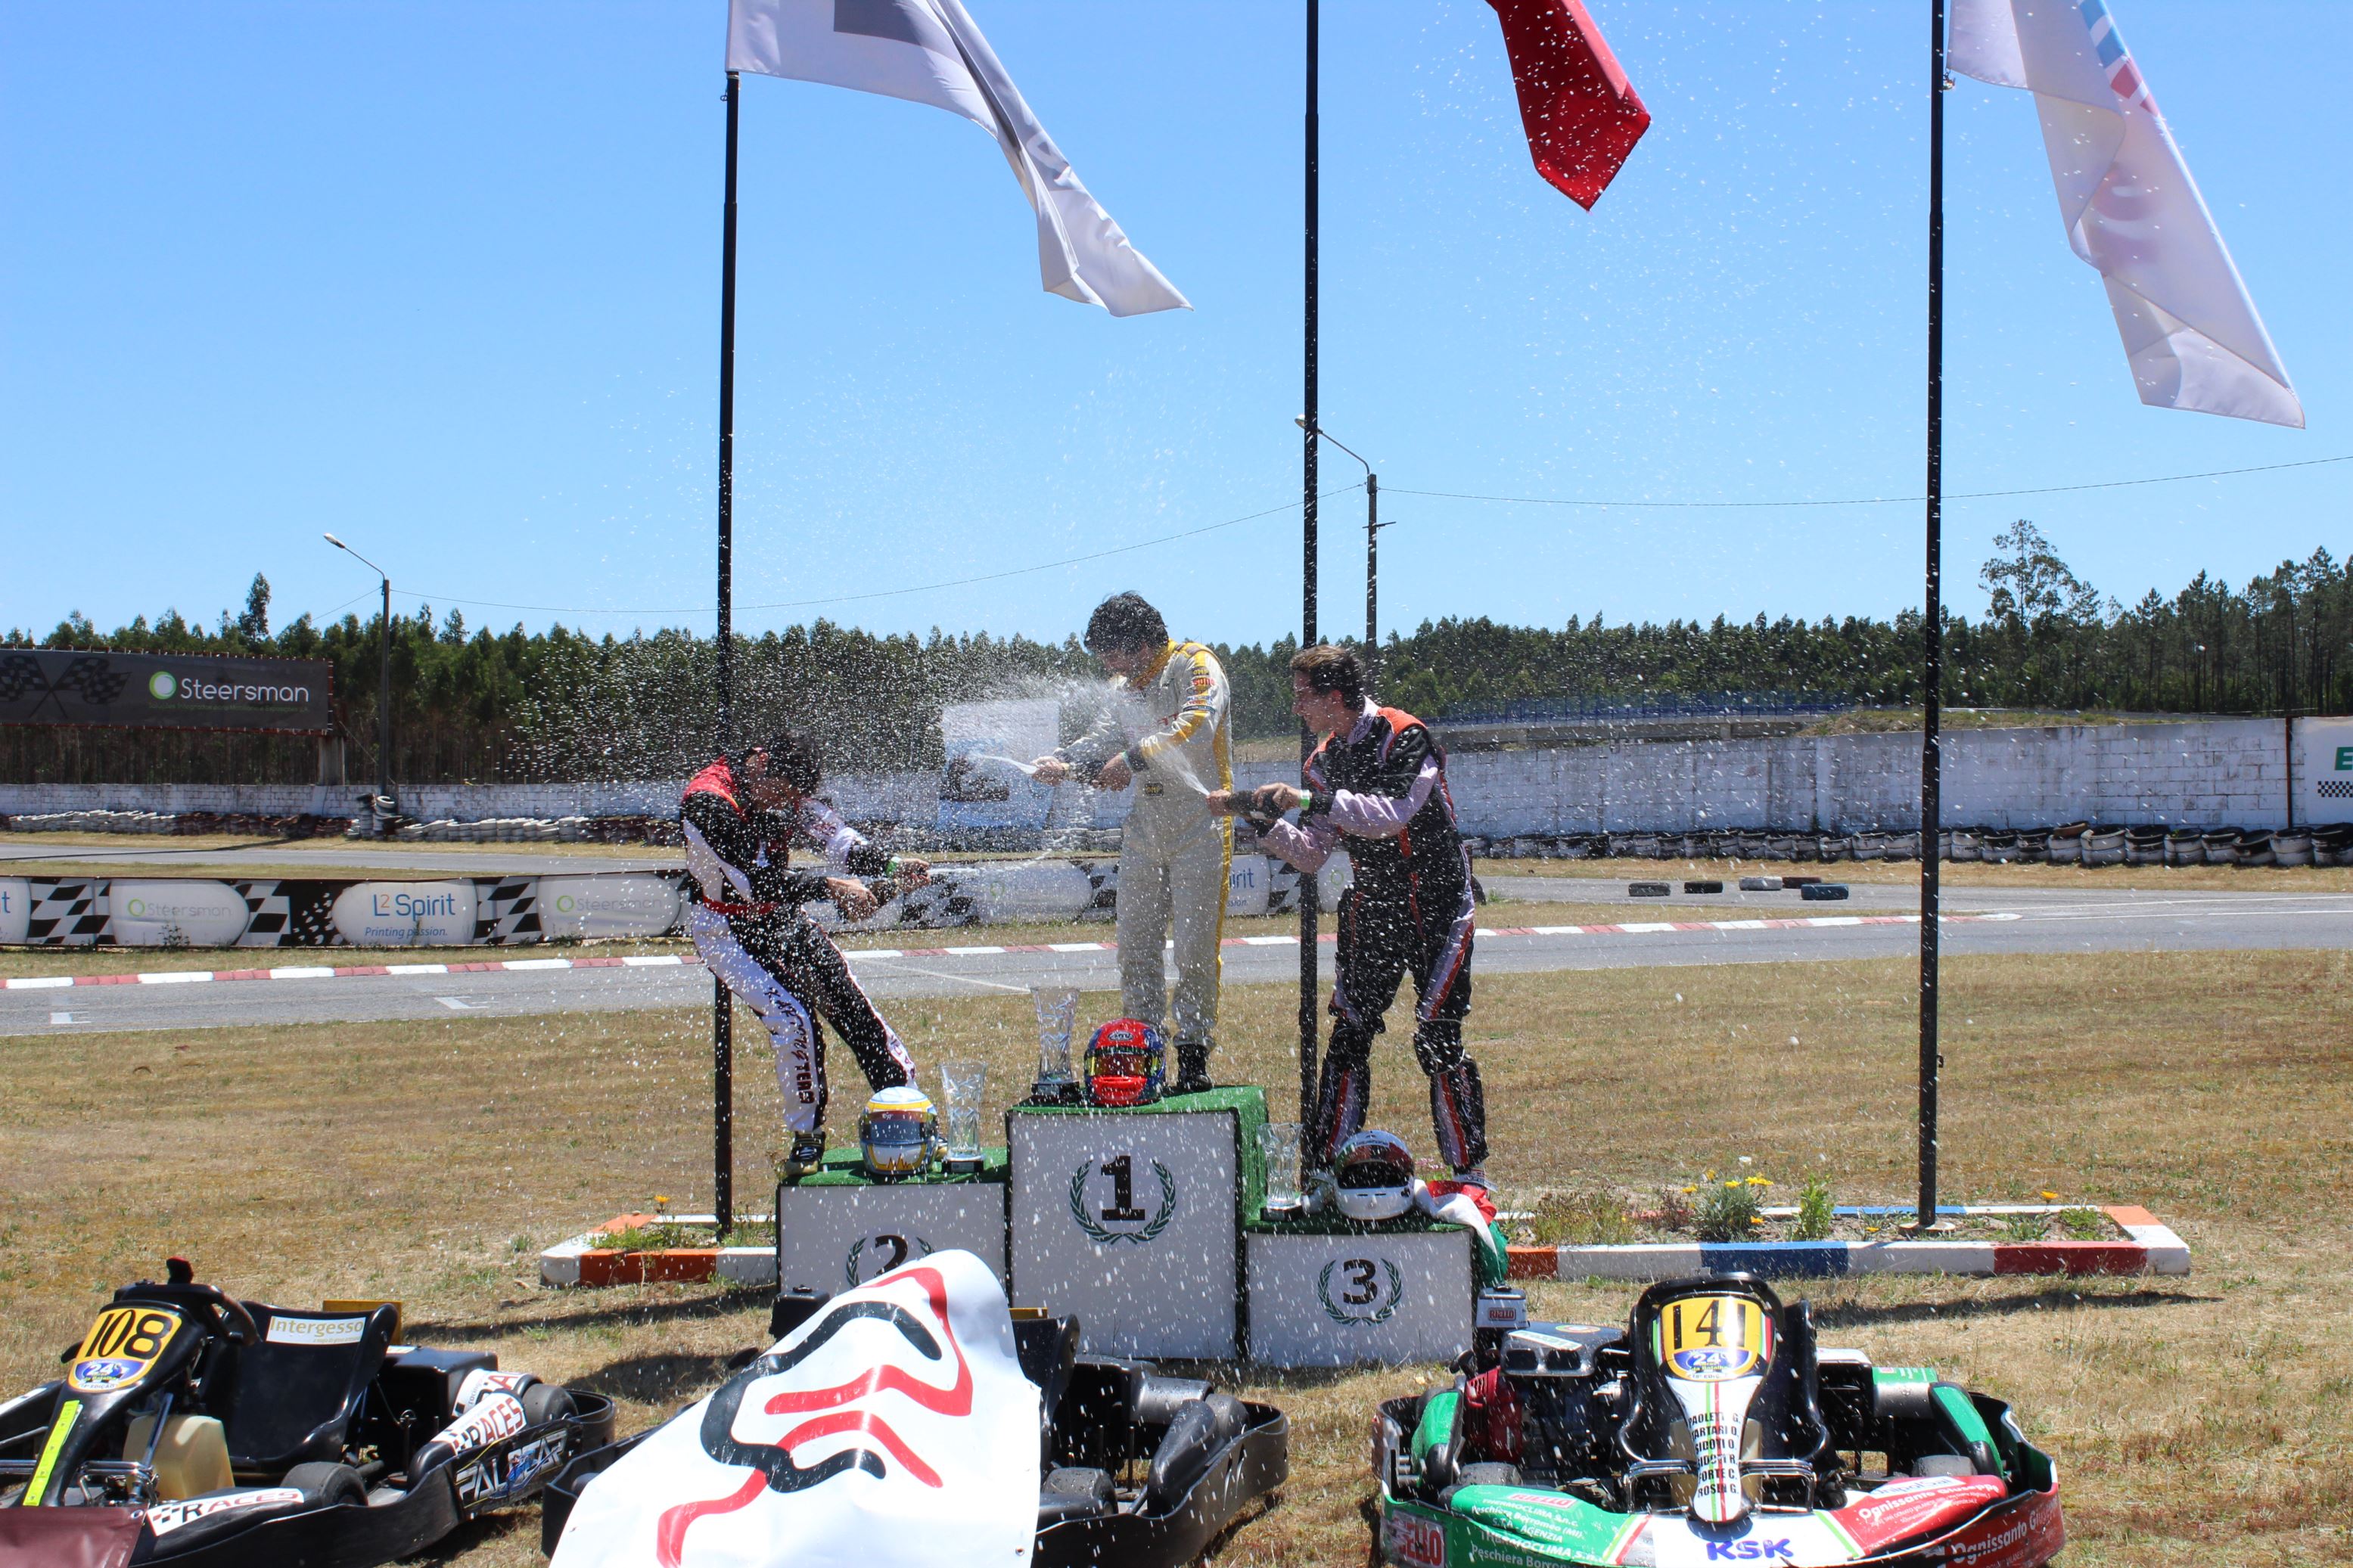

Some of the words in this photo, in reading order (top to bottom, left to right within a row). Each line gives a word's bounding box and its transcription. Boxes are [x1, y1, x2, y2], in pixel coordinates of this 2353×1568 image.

[181, 678, 309, 702] Steersman
[1229, 868, 1254, 889] irit
[148, 902, 232, 917] Steersman
[396, 893, 455, 921] Spirit
[577, 898, 662, 911] Steersman
[365, 927, 406, 939] Printing
[1100, 1156, 1145, 1221] 1
[1343, 1259, 1378, 1305] 3
[85, 1309, 173, 1360] 108
[270, 1318, 363, 1337] Intergesso
[1482, 1498, 1552, 1519] THERMOCLIMA
[1512, 1494, 1570, 1507] RIELLO
[1858, 1491, 1936, 1523] Ognissanto
[1937, 1483, 2000, 1495] Giuseppe
[1513, 1512, 1562, 1532] Borromeo
[1521, 1525, 1563, 1544] AGENZIA
[1952, 1522, 2028, 1566] Ognissanto
[1471, 1544, 1523, 1566] Peschiera
[1706, 1539, 1794, 1561] KSK
